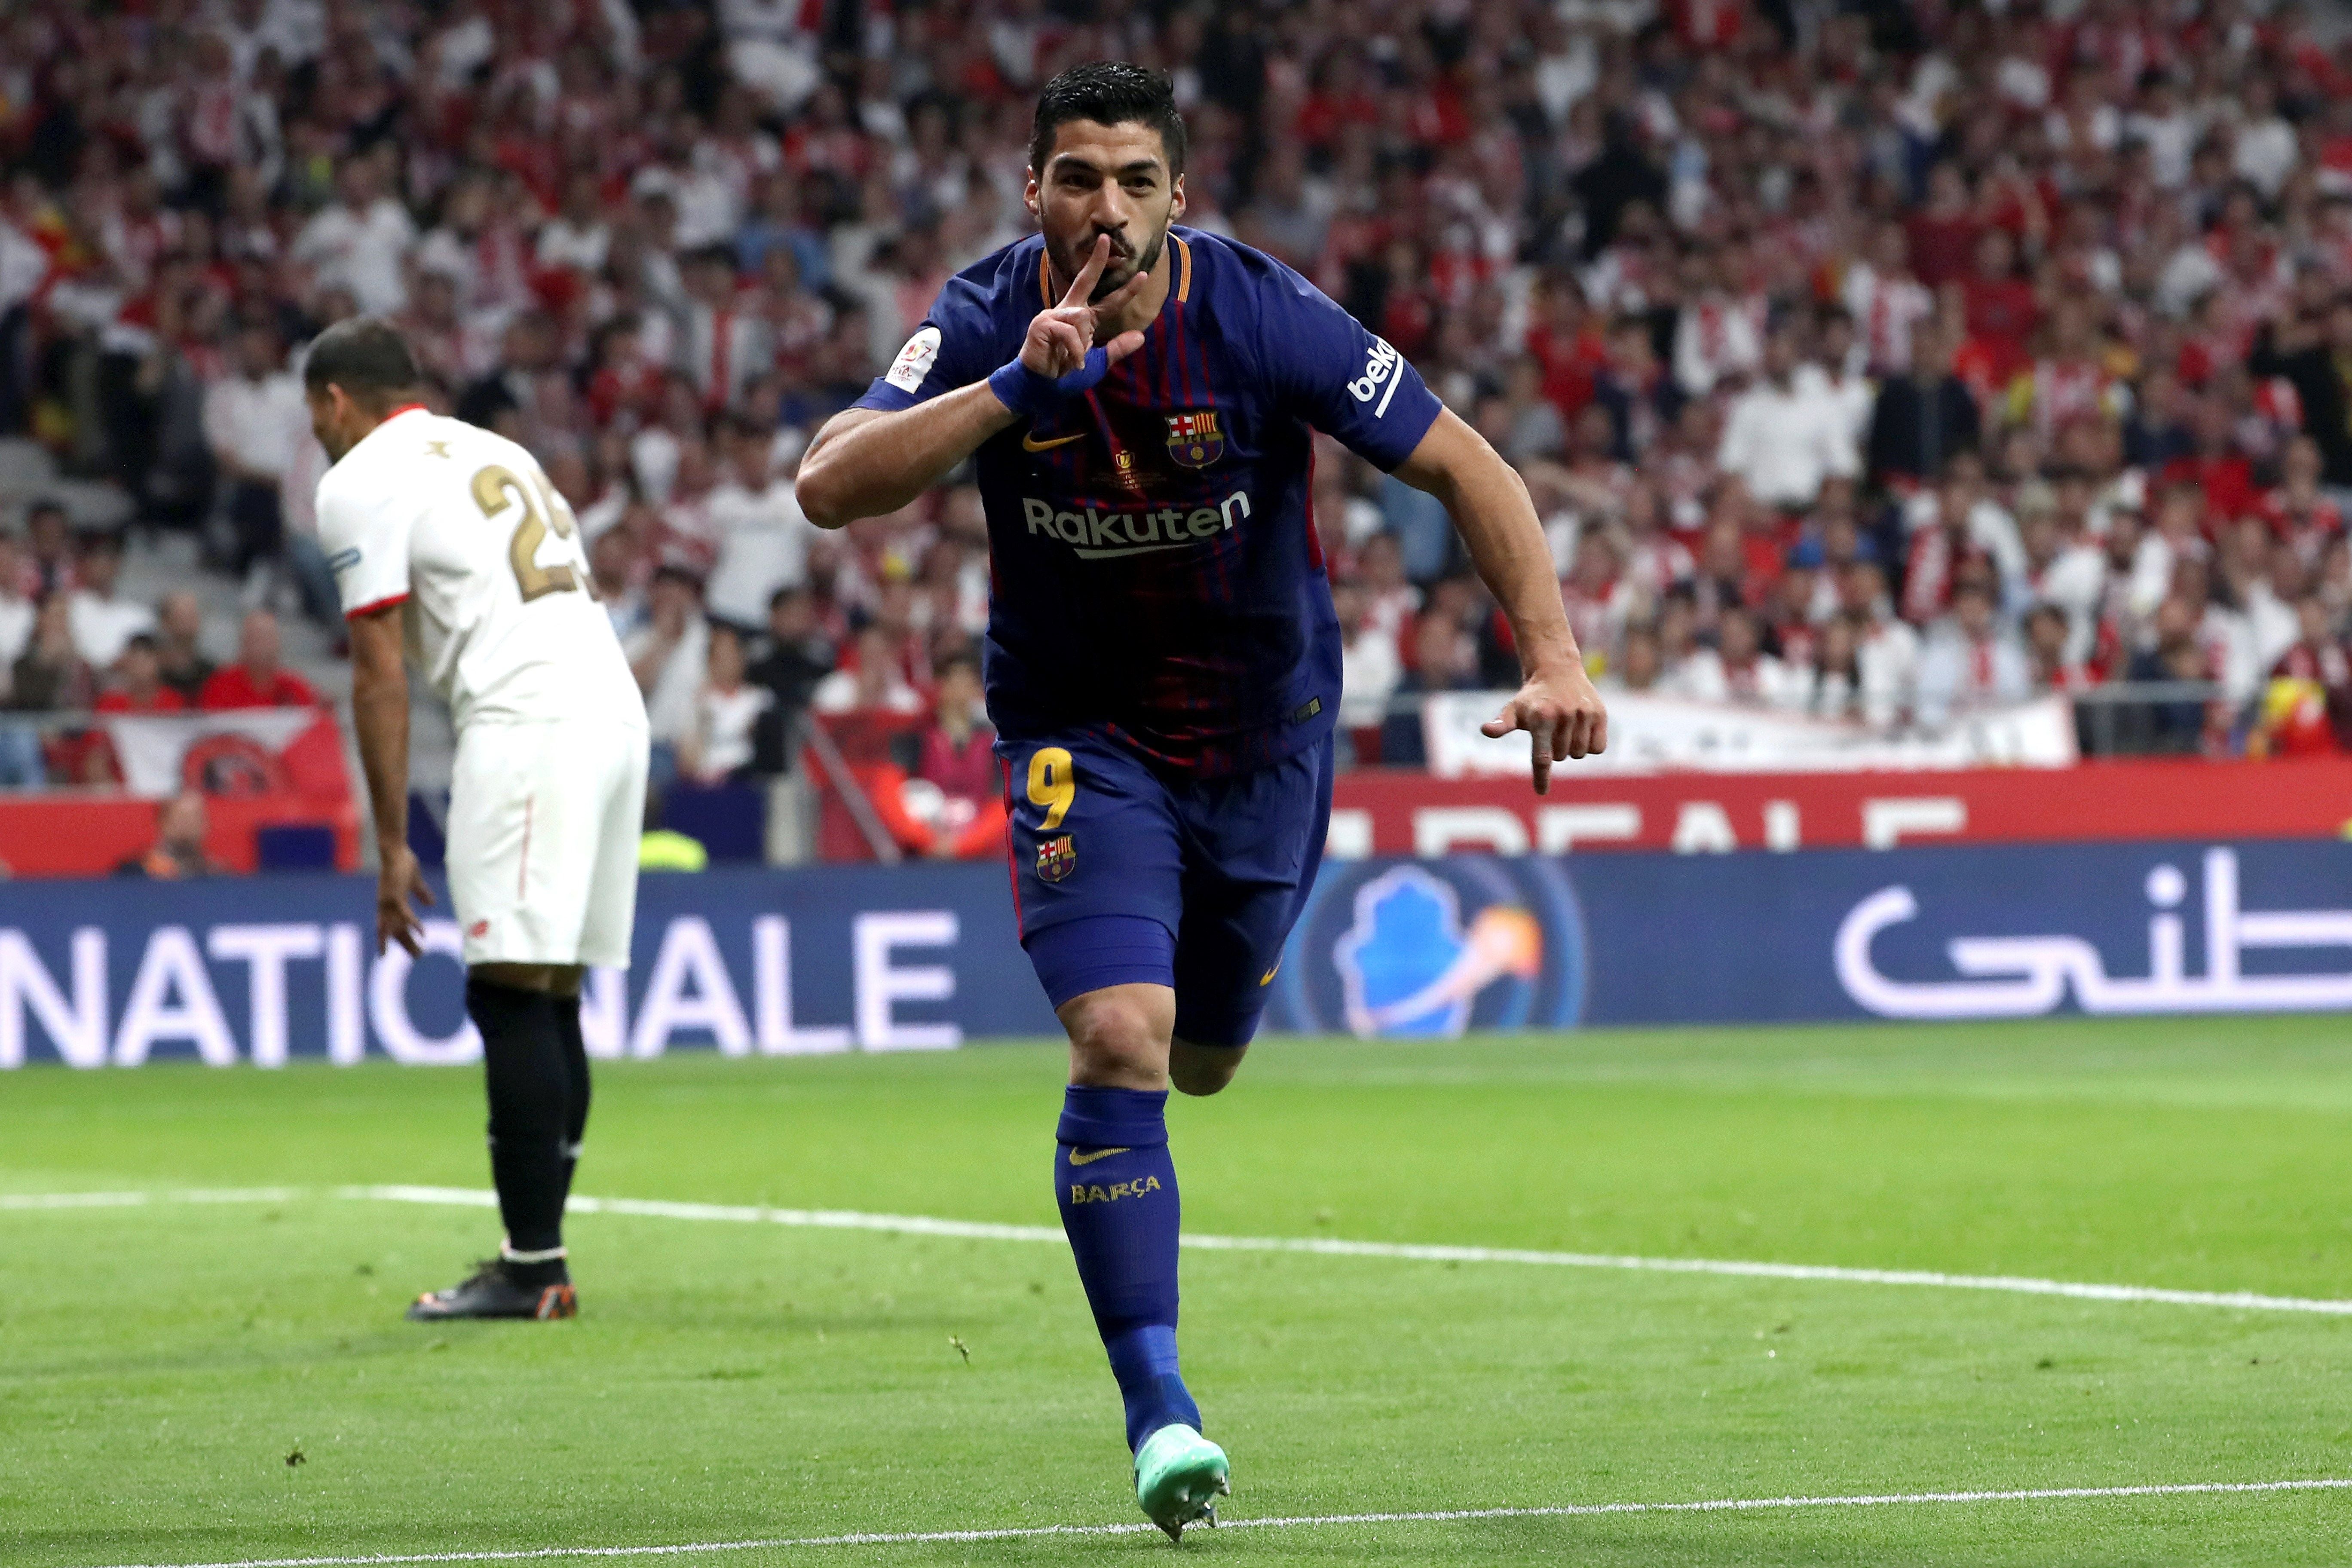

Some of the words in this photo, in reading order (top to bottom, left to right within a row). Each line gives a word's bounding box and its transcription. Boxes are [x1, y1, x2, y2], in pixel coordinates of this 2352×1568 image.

[1347, 337, 1396, 402] beko
[1023, 491, 1251, 545] Rakuten
[1026, 747, 1075, 831] 9
[1071, 1176, 1161, 1204] BARÇA
